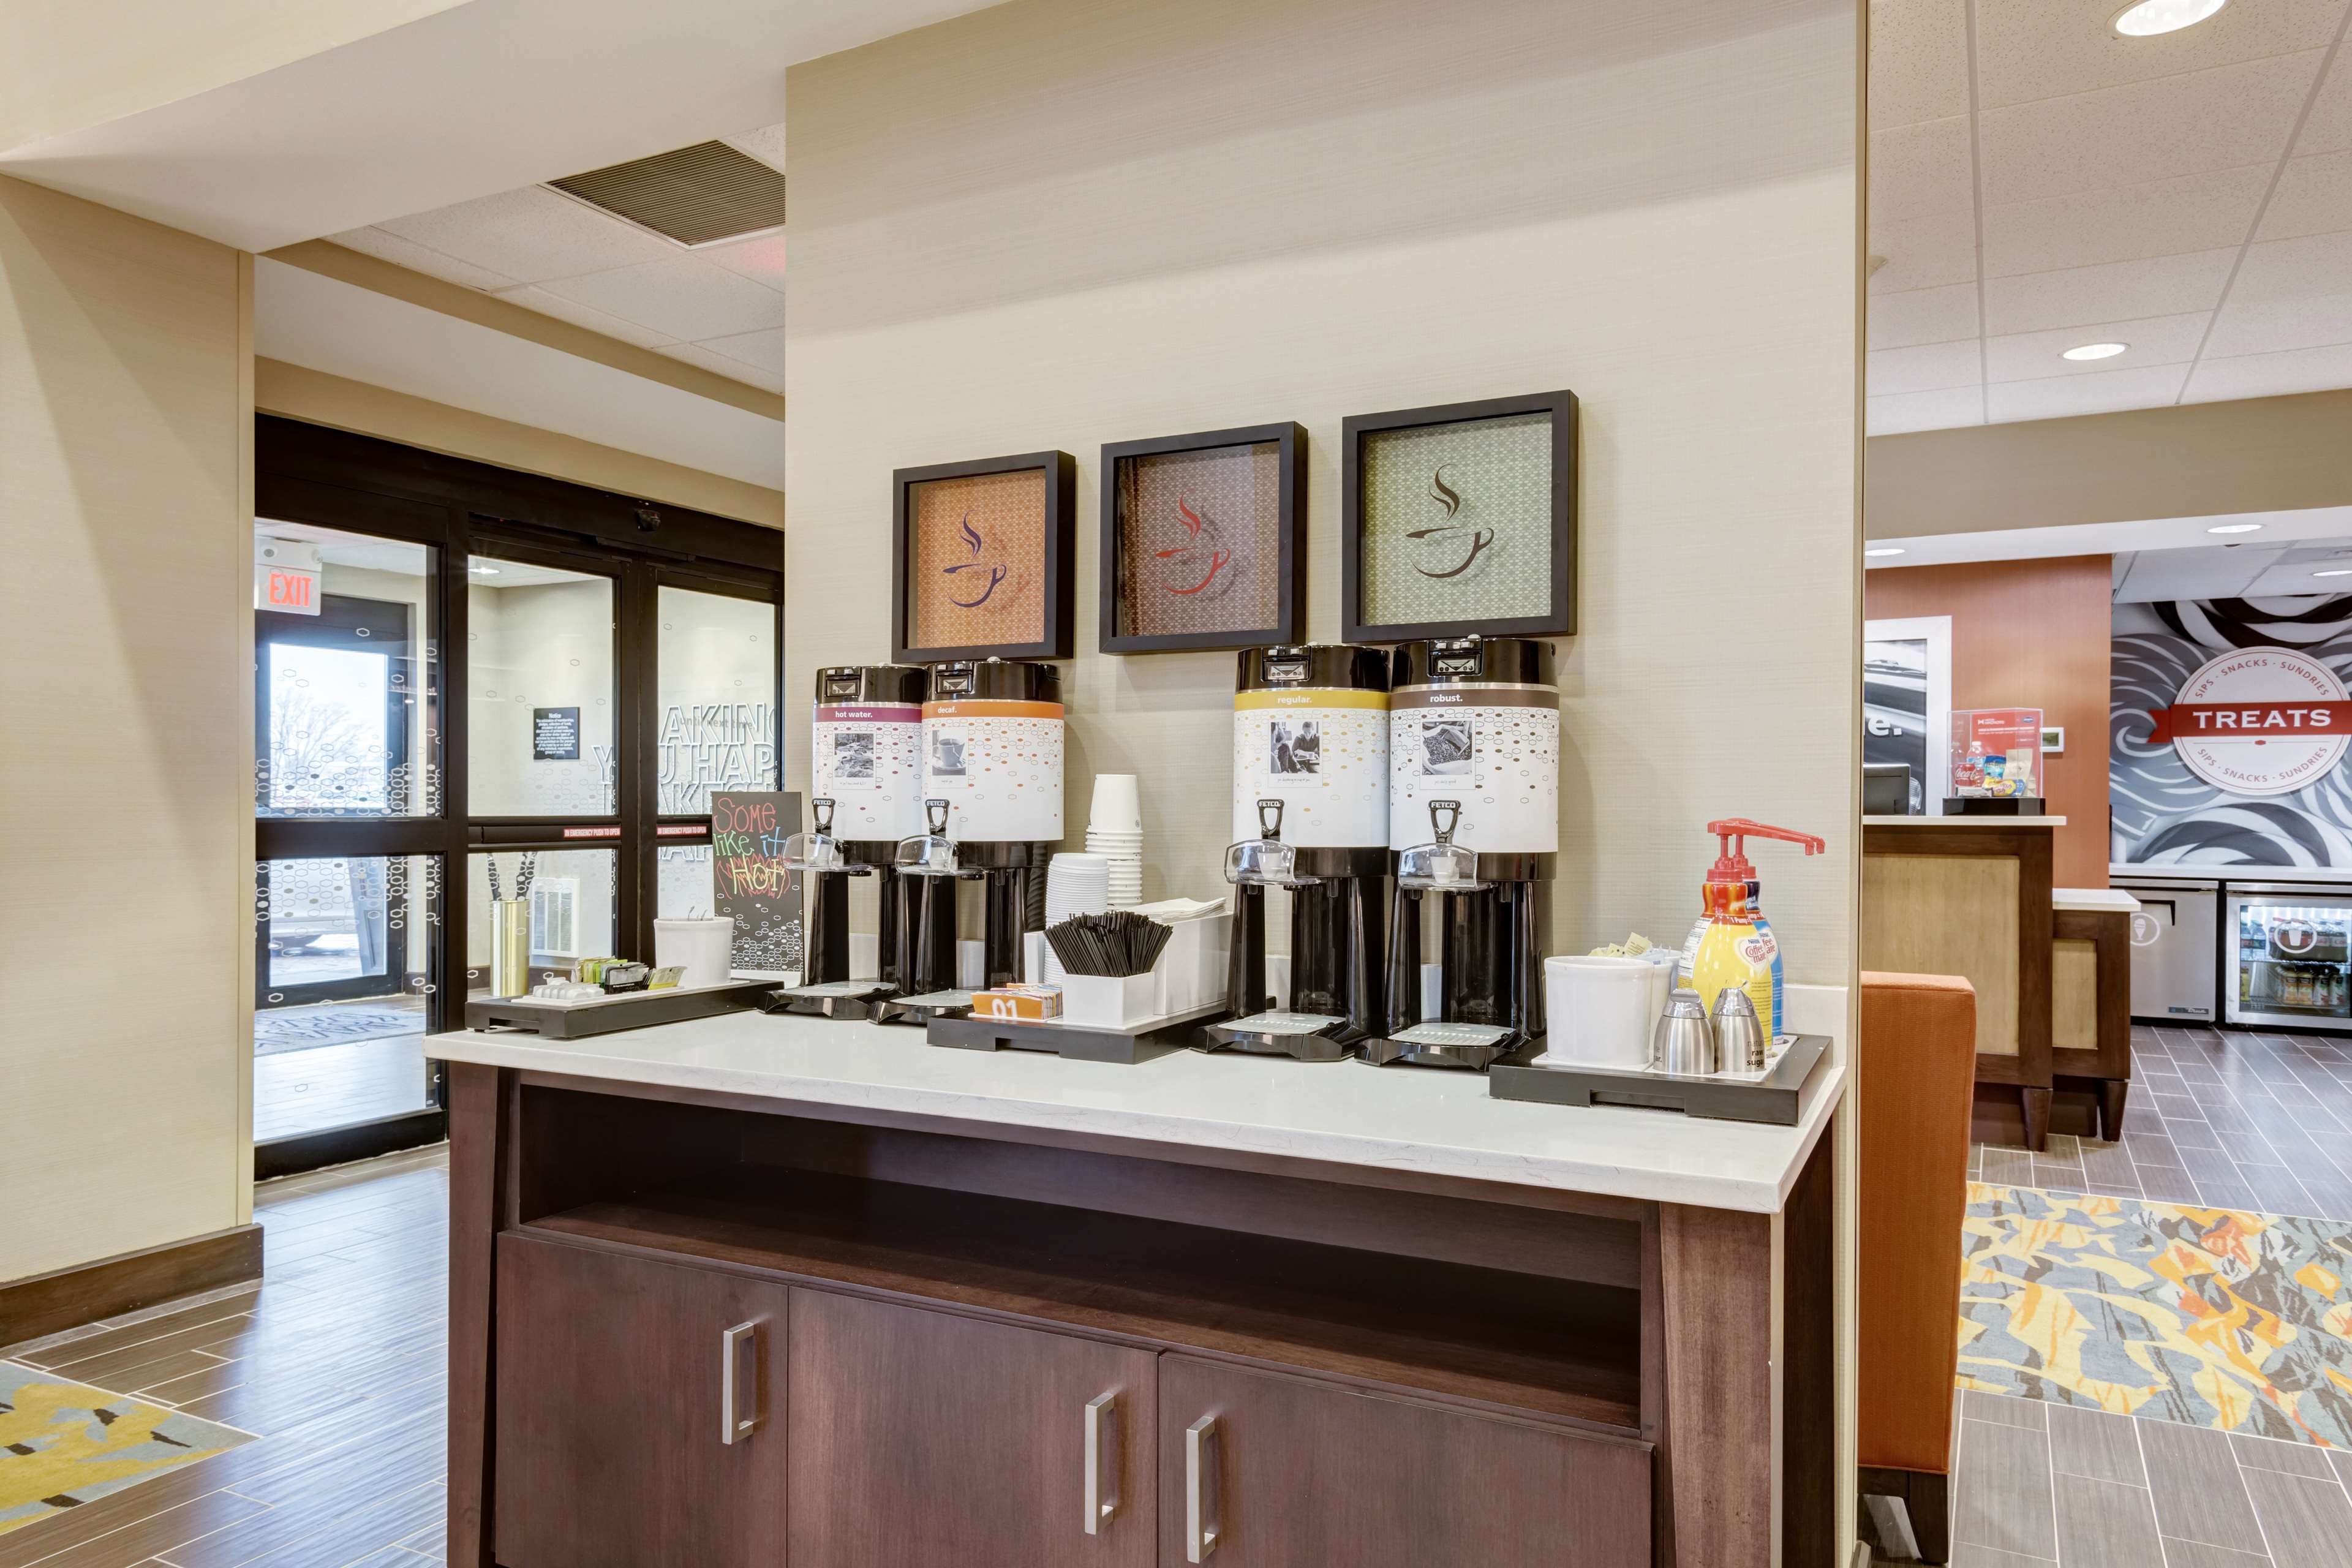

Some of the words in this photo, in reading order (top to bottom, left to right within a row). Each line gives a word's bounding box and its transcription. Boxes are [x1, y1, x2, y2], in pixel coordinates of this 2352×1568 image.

[269, 572, 312, 608] EXIT
[2195, 679, 2214, 698] SIPS
[2221, 659, 2267, 676] SNACKS
[2280, 662, 2329, 696] SUNDRIES
[1278, 696, 1312, 705] regular.
[2193, 709, 2331, 729] TREATS
[2198, 748, 2217, 766] SIPS
[2223, 767, 2267, 783] SNACKS
[2279, 747, 2328, 780] SUNDRIES
[760, 826, 786, 858] it
[1747, 1059, 1764, 1068] suga
